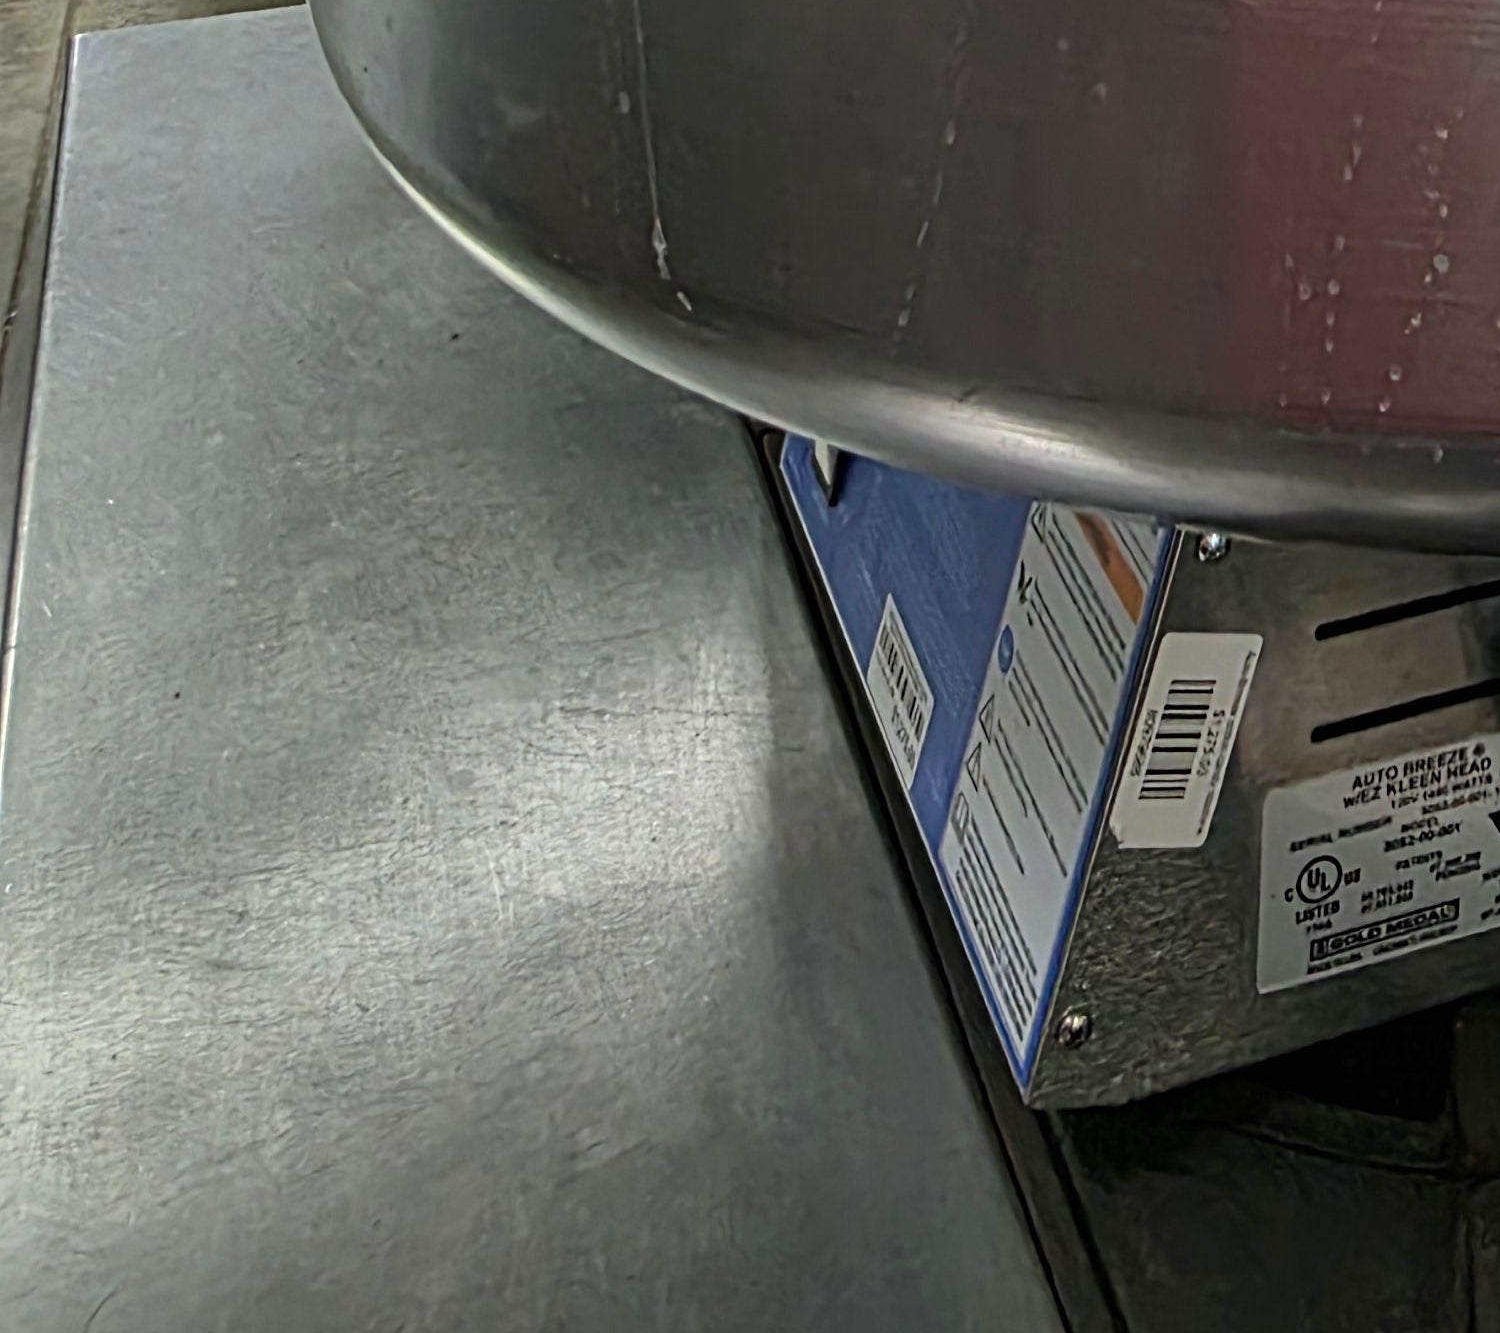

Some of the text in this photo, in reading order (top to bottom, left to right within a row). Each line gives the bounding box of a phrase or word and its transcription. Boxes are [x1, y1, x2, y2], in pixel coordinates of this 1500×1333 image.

[1352, 747, 1468, 790] AUTO BREEZE
[1387, 770, 1442, 797] KLEEN
[1447, 757, 1492, 780] HEAD
[1307, 867, 1331, 892] UL
[1295, 900, 1340, 925] LISTED
[1329, 927, 1383, 950] GOLD
[1386, 905, 1450, 937] MEDAL
